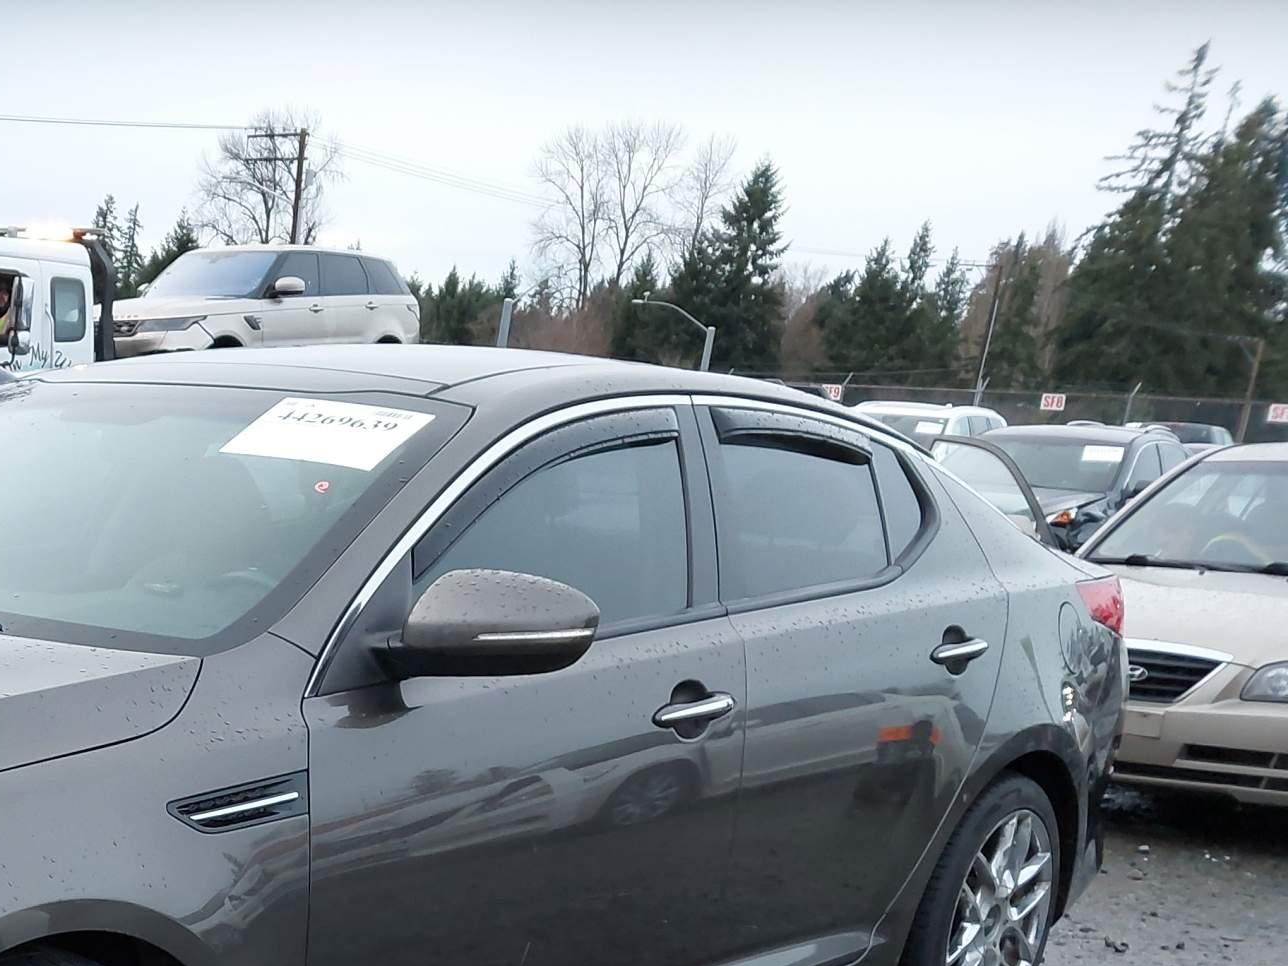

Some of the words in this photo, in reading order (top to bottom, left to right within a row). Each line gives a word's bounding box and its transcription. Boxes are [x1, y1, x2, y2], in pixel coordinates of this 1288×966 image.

[29, 343, 48, 368] My
[1043, 395, 1064, 408] SF8
[277, 410, 398, 431] 44269639
